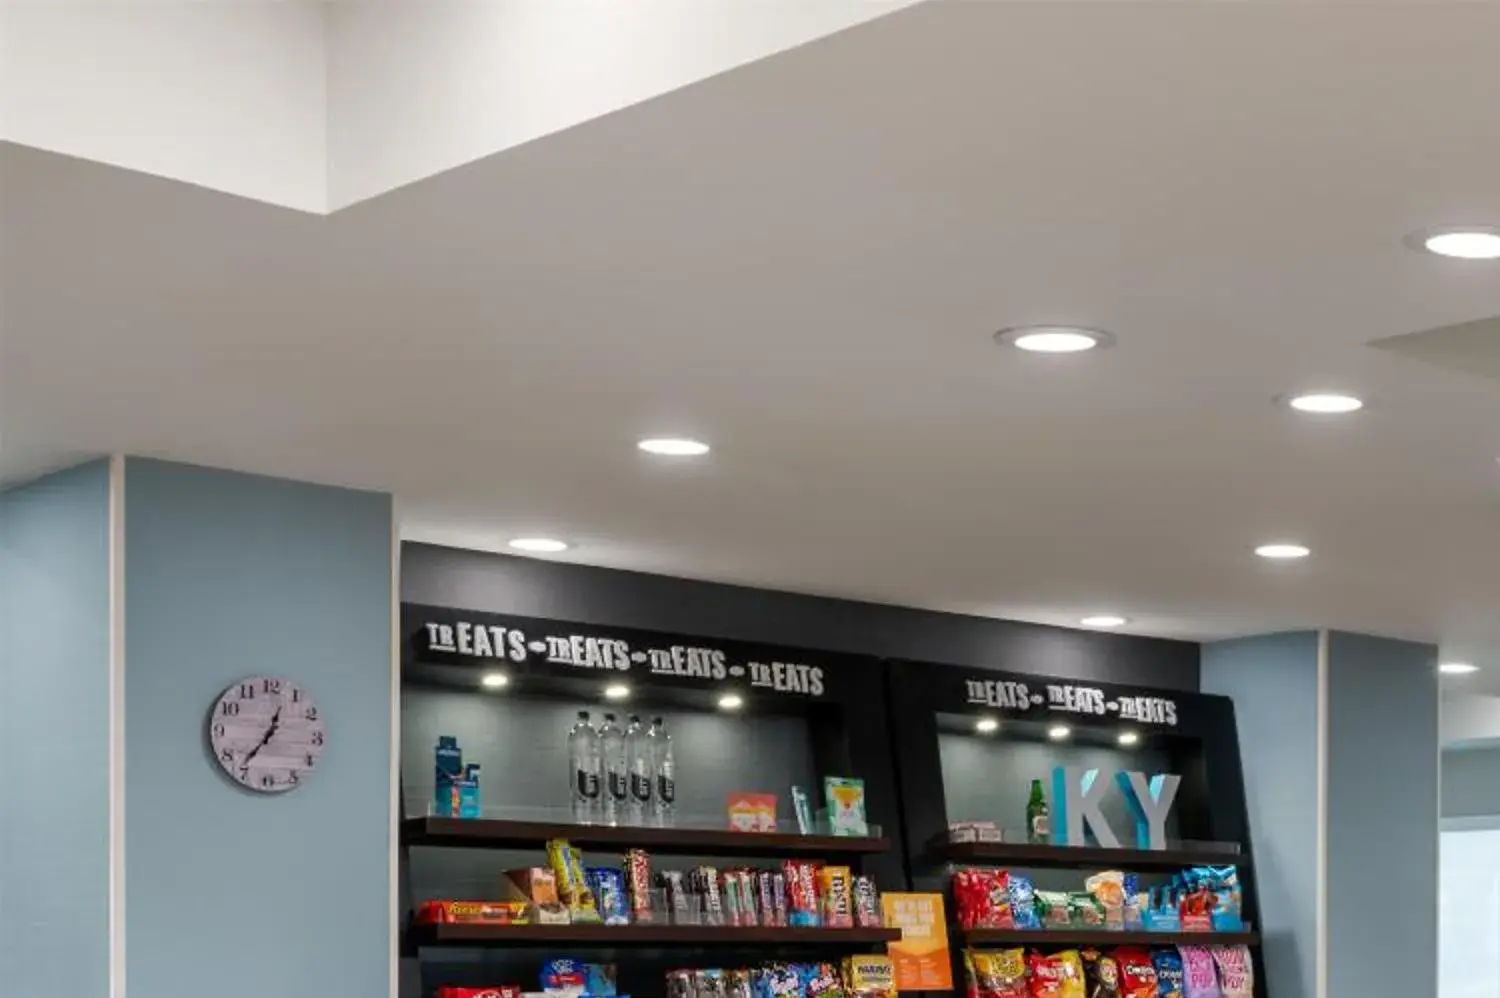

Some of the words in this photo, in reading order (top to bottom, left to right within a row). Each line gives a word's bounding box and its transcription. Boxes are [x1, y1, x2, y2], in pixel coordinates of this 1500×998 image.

[425, 621, 527, 662] TREATS
[545, 635, 631, 671] TREATS
[647, 645, 727, 680] TREATS
[748, 661, 824, 696] TREATS
[240, 684, 254, 699] 11
[263, 679, 281, 694] 12
[965, 680, 1031, 710] TREATS
[1046, 685, 1106, 715] TREATS
[222, 701, 239, 716] 10
[305, 707, 317, 721] 2
[311, 731, 323, 746] 3
[239, 766, 249, 780] 7
[1053, 766, 1182, 850] KY
